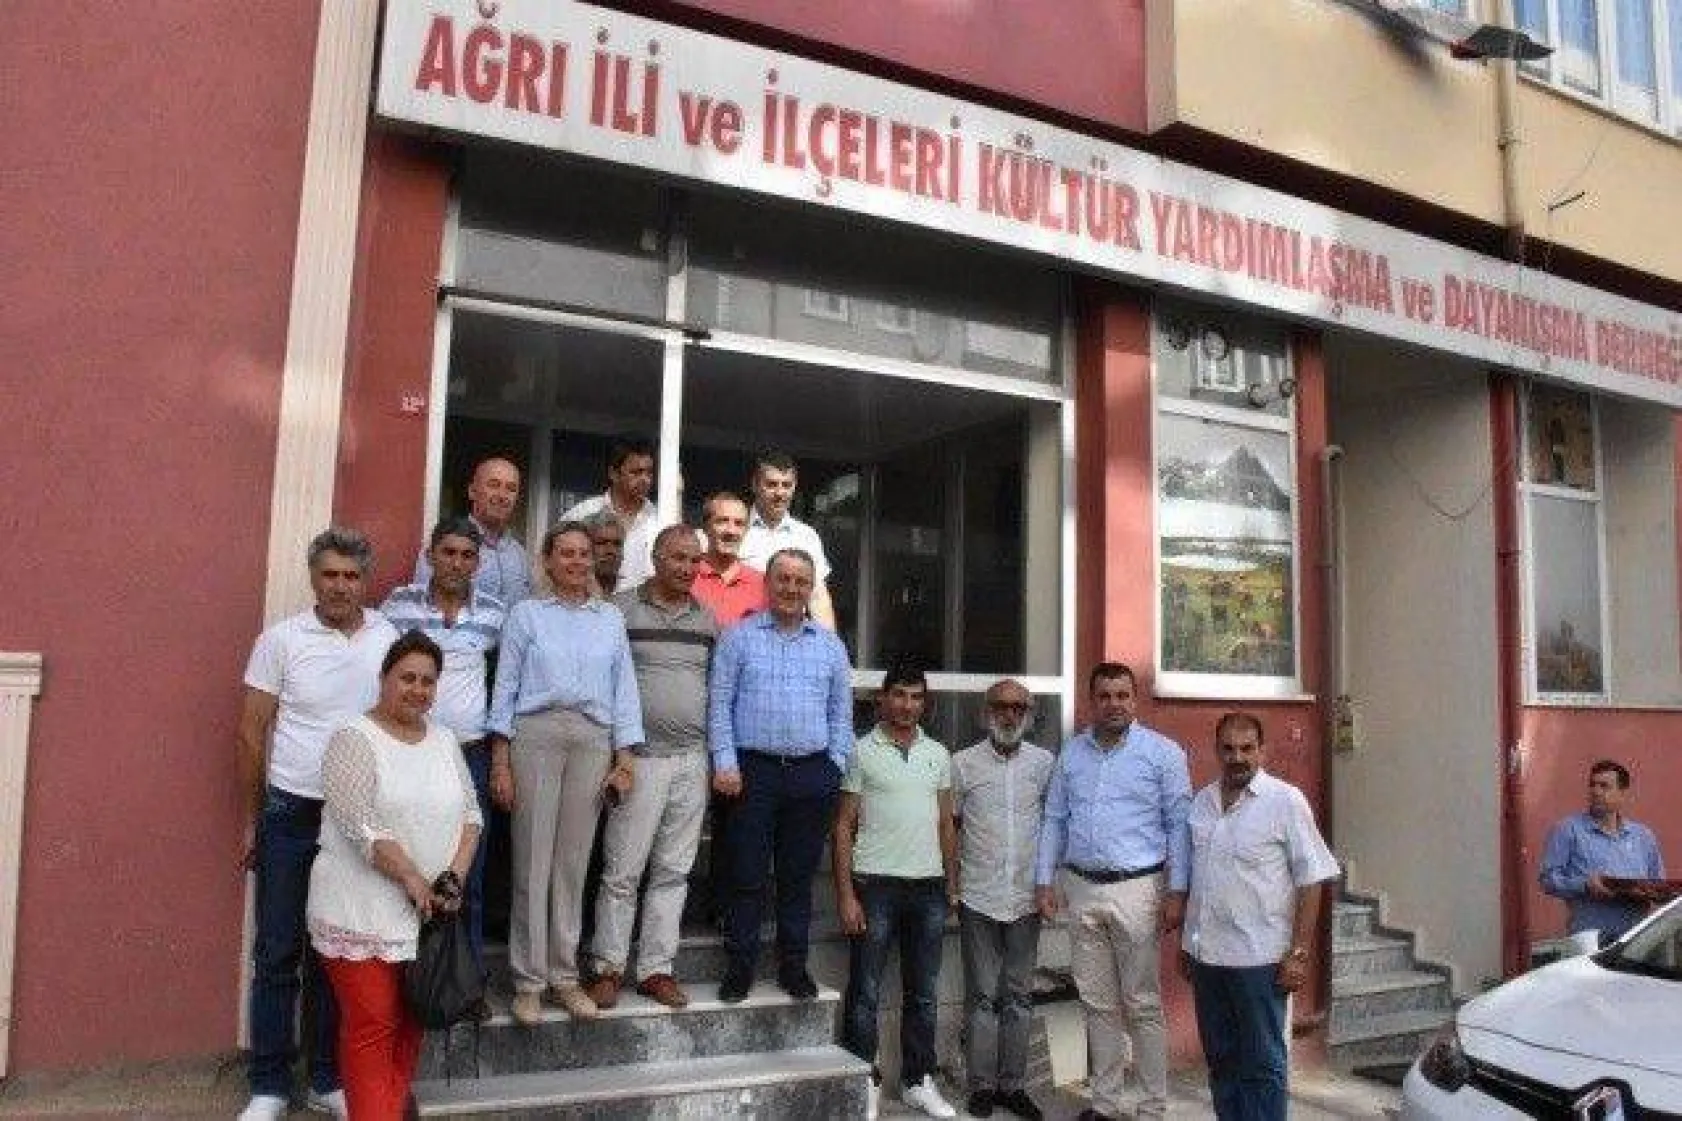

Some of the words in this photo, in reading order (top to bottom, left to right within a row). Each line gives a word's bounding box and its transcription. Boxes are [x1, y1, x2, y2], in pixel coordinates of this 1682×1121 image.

[415, 0, 572, 119] AĞRI
[589, 26, 660, 138] İLİ
[678, 91, 744, 154] ve
[763, 67, 962, 203] İLÇELERİ
[977, 132, 1142, 252] KÜLTÜR
[1149, 189, 1395, 317] YARDIMLAŞMA
[1401, 278, 1433, 325] ve
[1444, 273, 1589, 369] DAYANIŞMA
